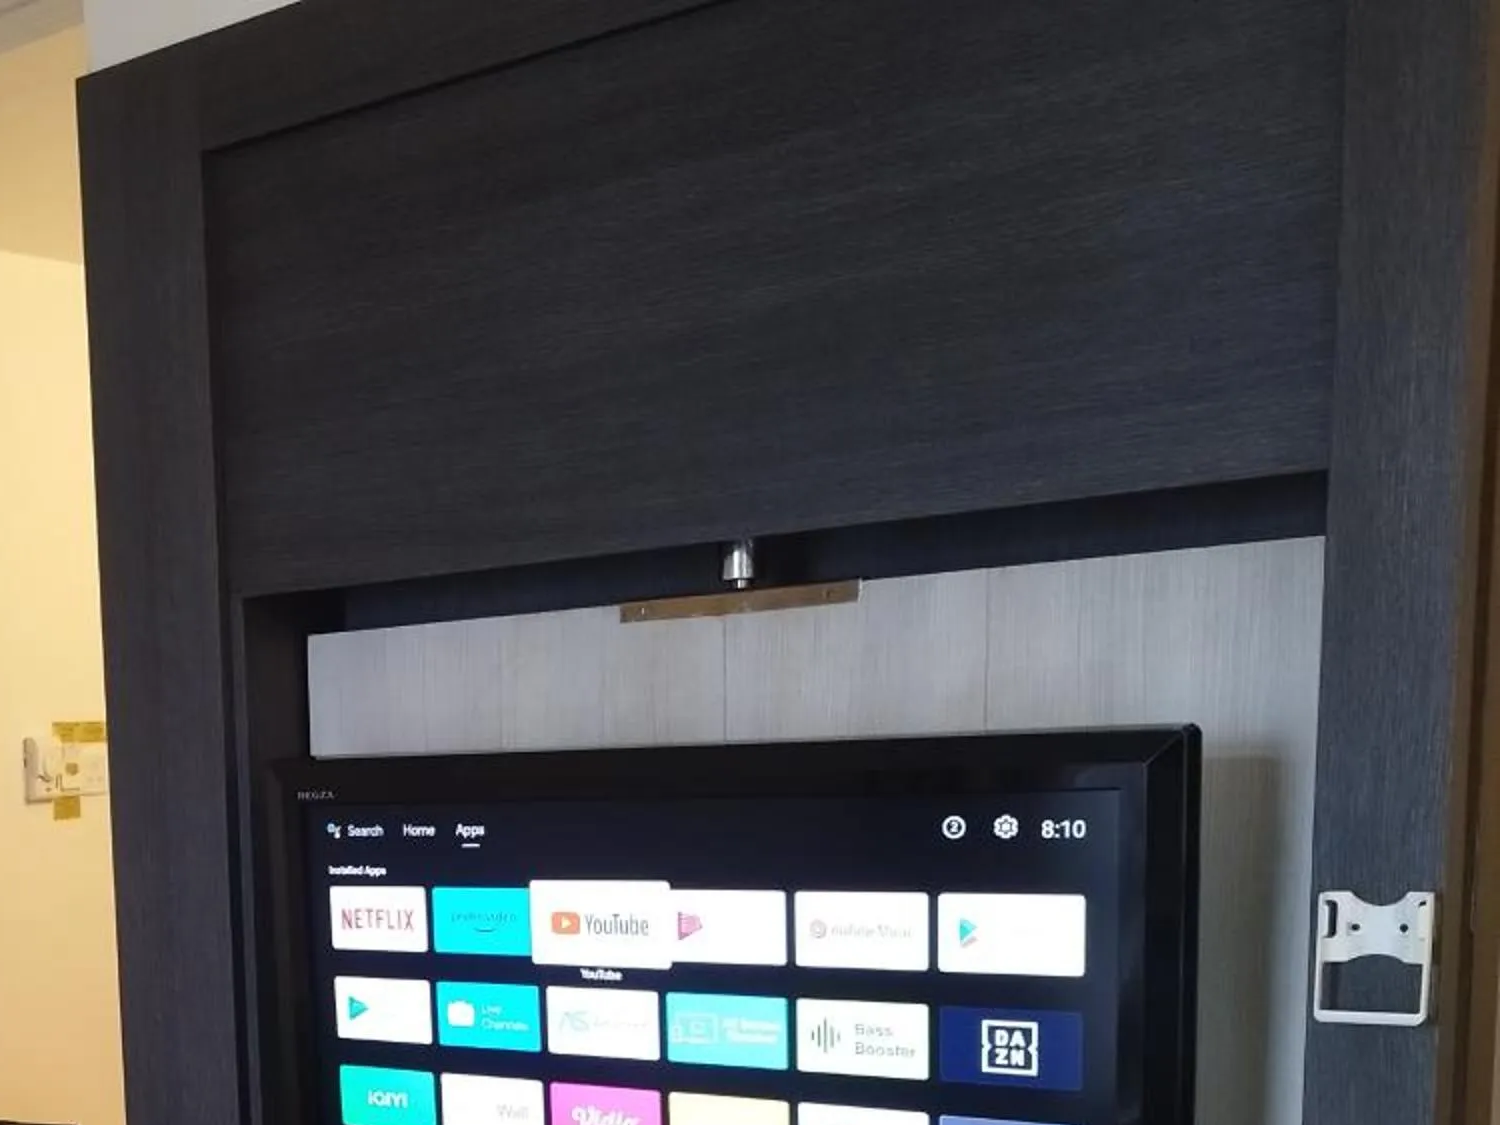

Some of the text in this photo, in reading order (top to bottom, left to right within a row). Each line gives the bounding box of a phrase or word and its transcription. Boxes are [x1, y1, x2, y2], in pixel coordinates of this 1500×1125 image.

[347, 823, 485, 839] Search Home Apps
[1041, 819, 1087, 839] 8:10
[328, 865, 387, 877] Installed Apps
[341, 908, 415, 931] NETFLIX
[585, 914, 649, 936] YouTube
[580, 968, 622, 981] YouTube
[854, 1022, 894, 1037] Bass
[854, 1041, 917, 1058] Booster
